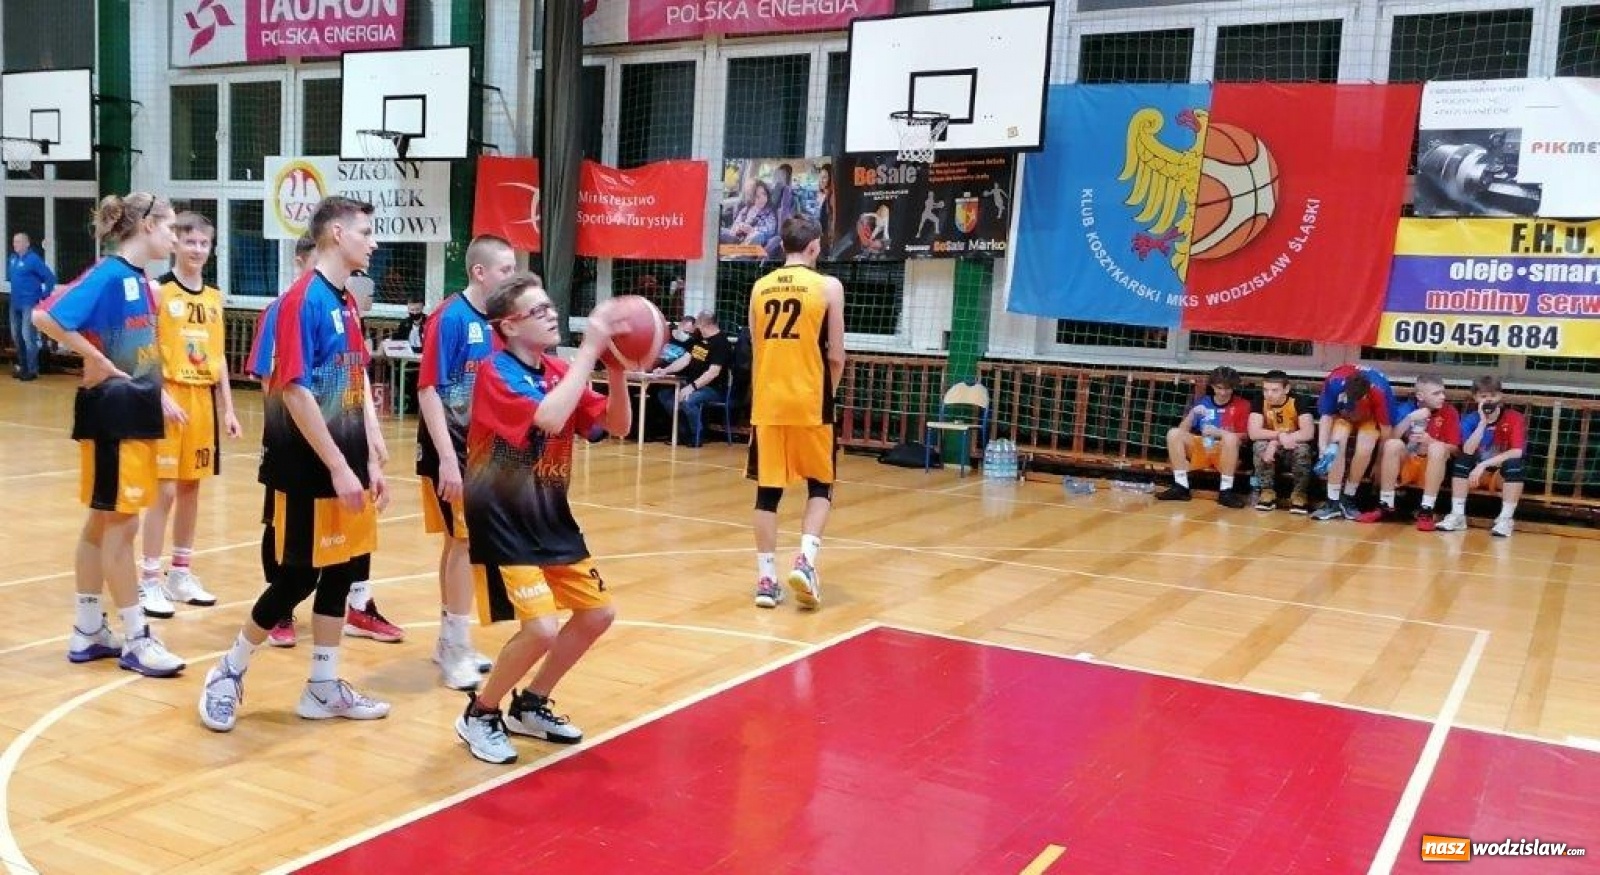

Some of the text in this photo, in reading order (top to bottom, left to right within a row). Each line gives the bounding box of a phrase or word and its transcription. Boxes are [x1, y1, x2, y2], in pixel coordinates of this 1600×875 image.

[667, 0, 858, 24] POLSKA ENERGIA
[261, 24, 396, 46] POLSKA ENERGIA
[1531, 141, 1600, 154] PIKME
[854, 163, 917, 187] BeSafe
[1081, 188, 1095, 226] KLUB
[968, 238, 1006, 250] Marko
[1511, 223, 1594, 253] F.H.U.
[1086, 231, 1162, 303] KOSZYKARSKI
[1450, 259, 1514, 283] oleje
[1205, 253, 1292, 306] WODZISŁAW
[1166, 293, 1199, 307] MKS
[1426, 289, 1530, 315] mobilny
[187, 302, 206, 324] 20
[764, 298, 801, 340] 22
[1395, 320, 1559, 349] 609 454 884
[194, 448, 210, 469] 20
